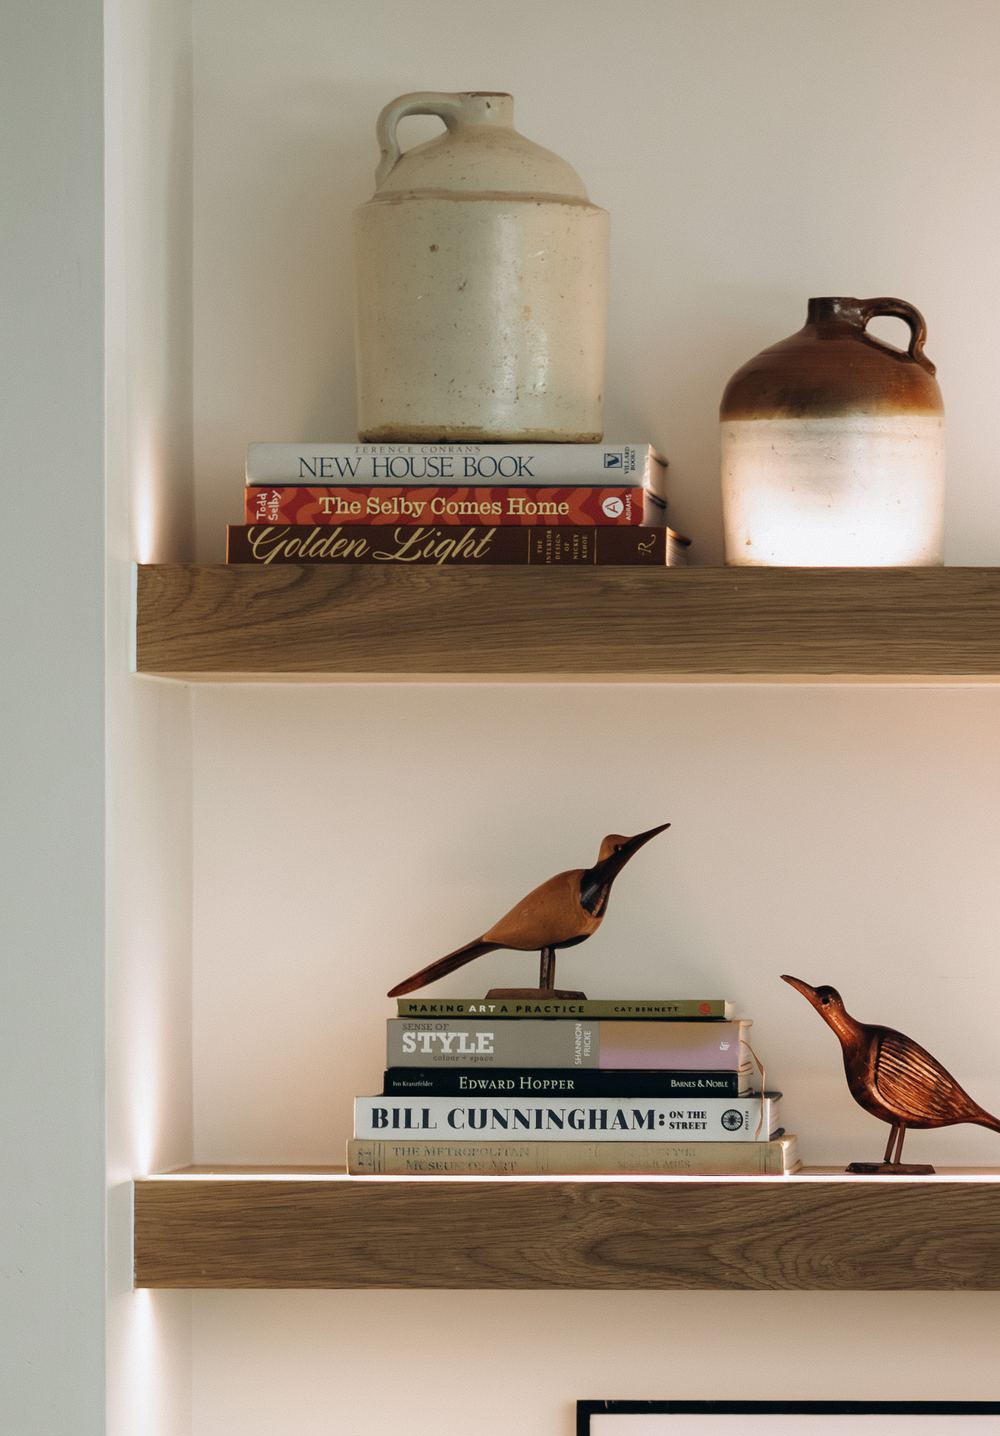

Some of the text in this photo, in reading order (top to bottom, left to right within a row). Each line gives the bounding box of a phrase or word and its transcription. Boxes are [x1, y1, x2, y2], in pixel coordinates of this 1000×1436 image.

[354, 446, 413, 454] TERENCE
[298, 455, 535, 478] NEW HOUSE BOOK
[256, 492, 268, 519] Todd
[268, 490, 282, 521] Selby
[318, 496, 569, 519] The Selby Comes Home
[247, 526, 497, 565] Golden Light
[564, 543, 570, 552] OF
[408, 1004, 464, 1013] MAKING
[468, 1004, 496, 1013] ART
[500, 1005, 508, 1013] A
[516, 1005, 585, 1013] PRACTICE
[402, 1023, 450, 1031] SENSE OF
[402, 1032, 494, 1054] STYLE
[574, 1023, 583, 1065] SHANNON
[583, 1030, 592, 1057] FRICKE
[459, 1076, 516, 1090] EDWARD
[520, 1076, 575, 1090] HOPPER
[670, 1079, 696, 1088] BARNES
[697, 1079, 705, 1088] &
[705, 1079, 729, 1088] NOBLE
[371, 1107, 666, 1130] BILL CUNNINGHAM:
[669, 1110, 708, 1119] ON THE
[669, 1121, 708, 1130] STREET
[392, 1146, 420, 1158] THE
